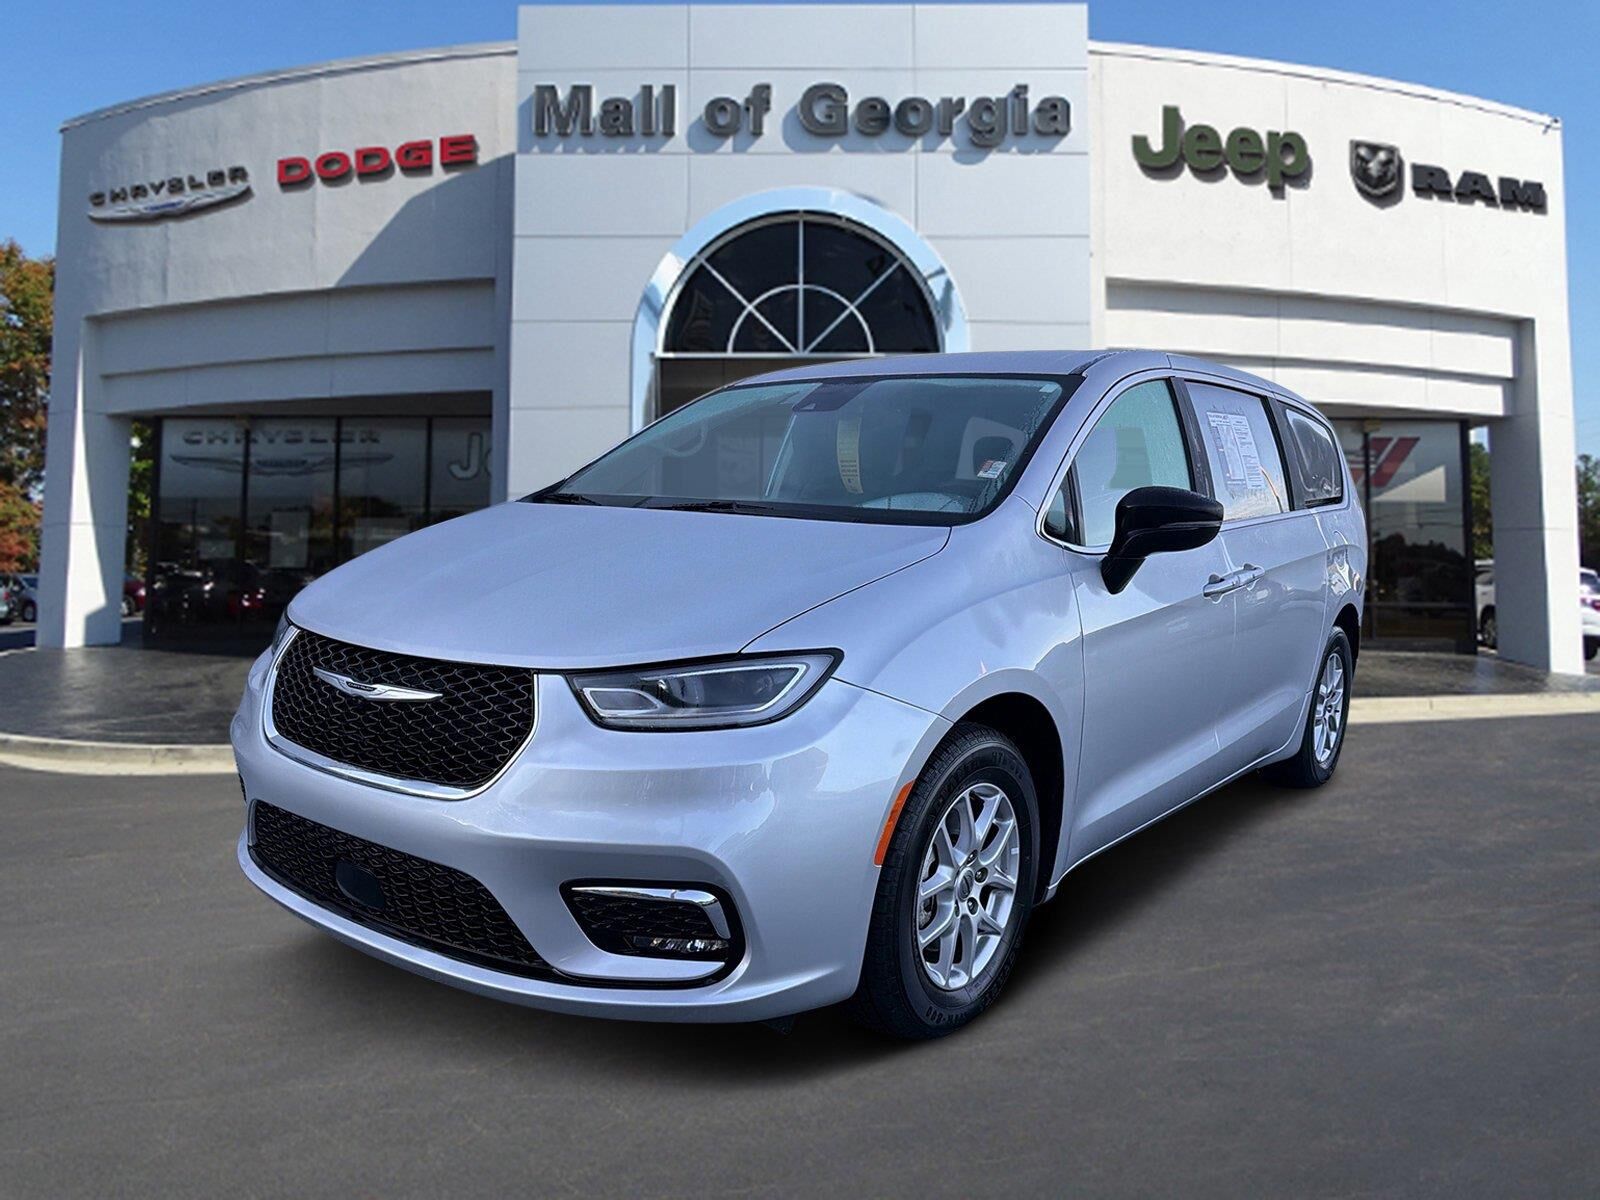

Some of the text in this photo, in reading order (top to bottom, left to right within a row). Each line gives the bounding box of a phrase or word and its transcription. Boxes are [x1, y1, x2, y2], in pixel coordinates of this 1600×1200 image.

[532, 82, 1073, 149] Mall of Georgia
[277, 134, 478, 187] DODGE
[1131, 105, 1311, 193] Jeep
[89, 165, 249, 207] CHRYSLER
[1411, 162, 1548, 214] RAM
[183, 429, 381, 446] CHRYSLER
[447, 431, 493, 480] J
